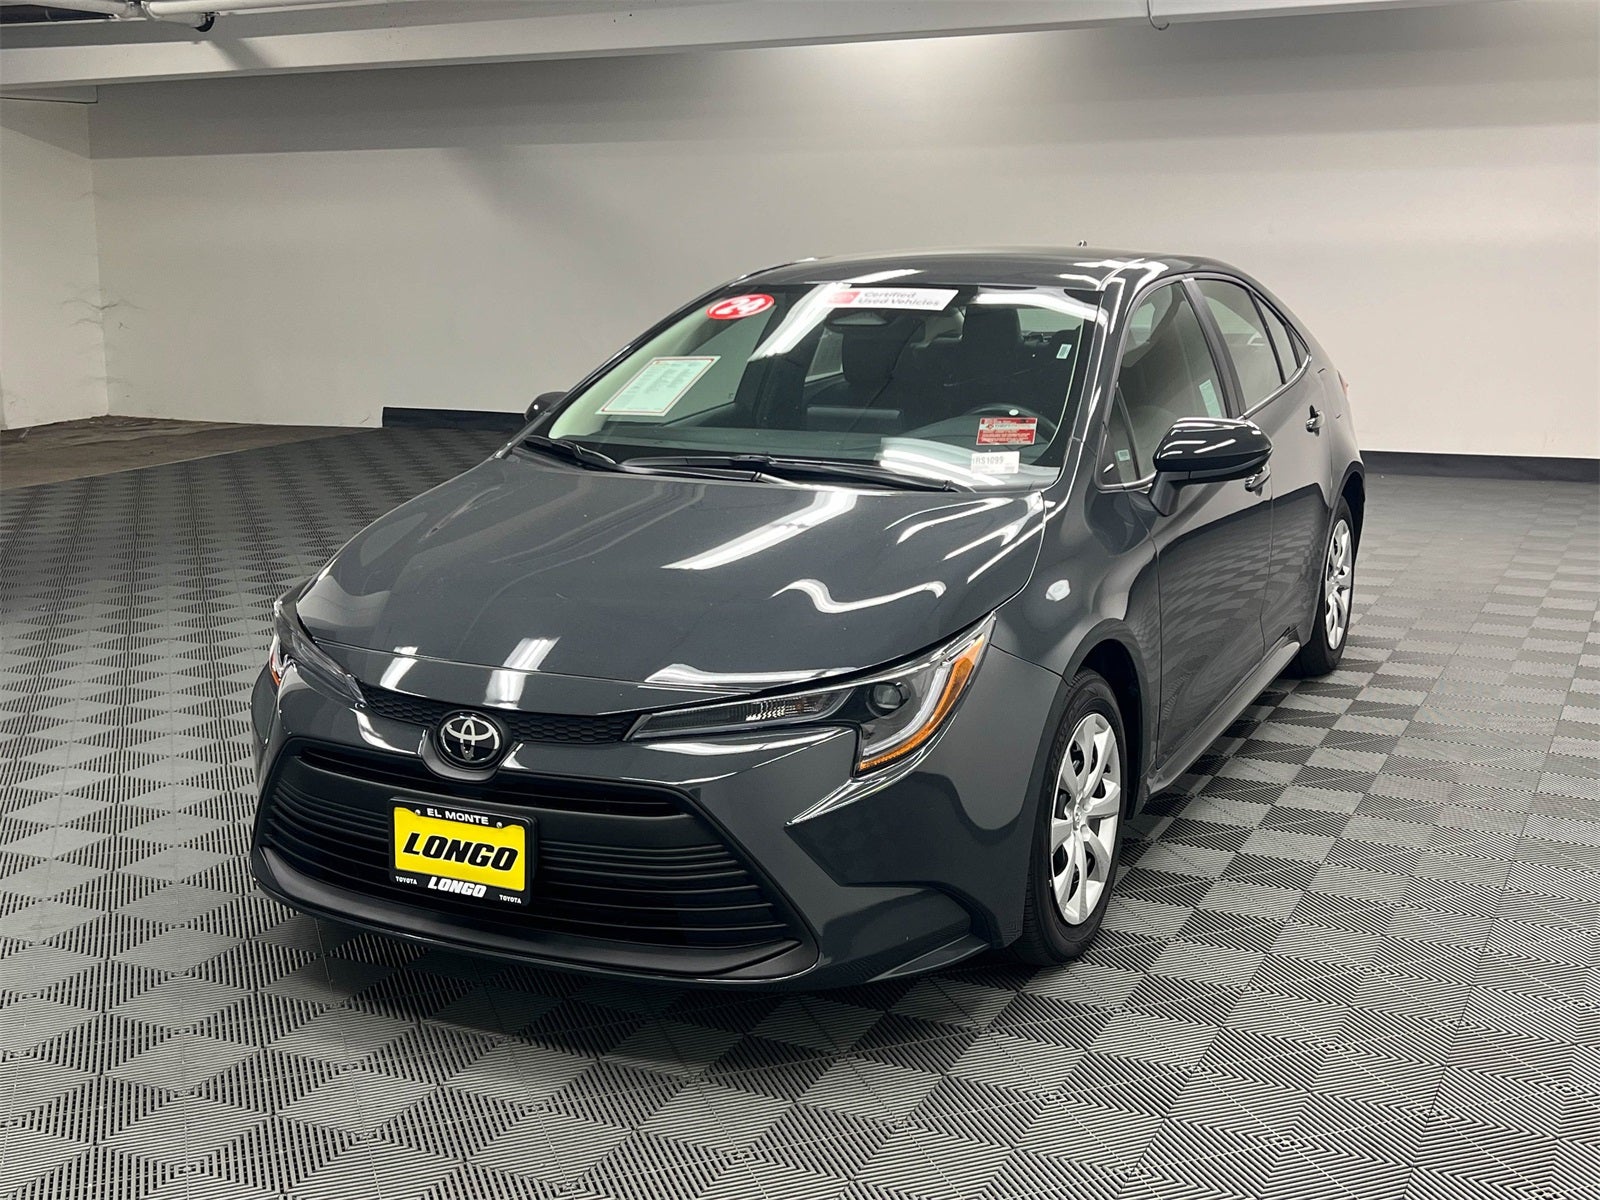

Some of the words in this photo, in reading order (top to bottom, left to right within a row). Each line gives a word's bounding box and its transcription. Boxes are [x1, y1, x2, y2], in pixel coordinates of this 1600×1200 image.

[715, 298, 765, 316] 24
[426, 807, 442, 818] EL
[445, 810, 489, 826] MONTE
[402, 832, 519, 871] LONGO
[395, 876, 418, 885] TOYOTA
[427, 876, 487, 899] LONGO
[499, 894, 522, 904] TOYOTA
